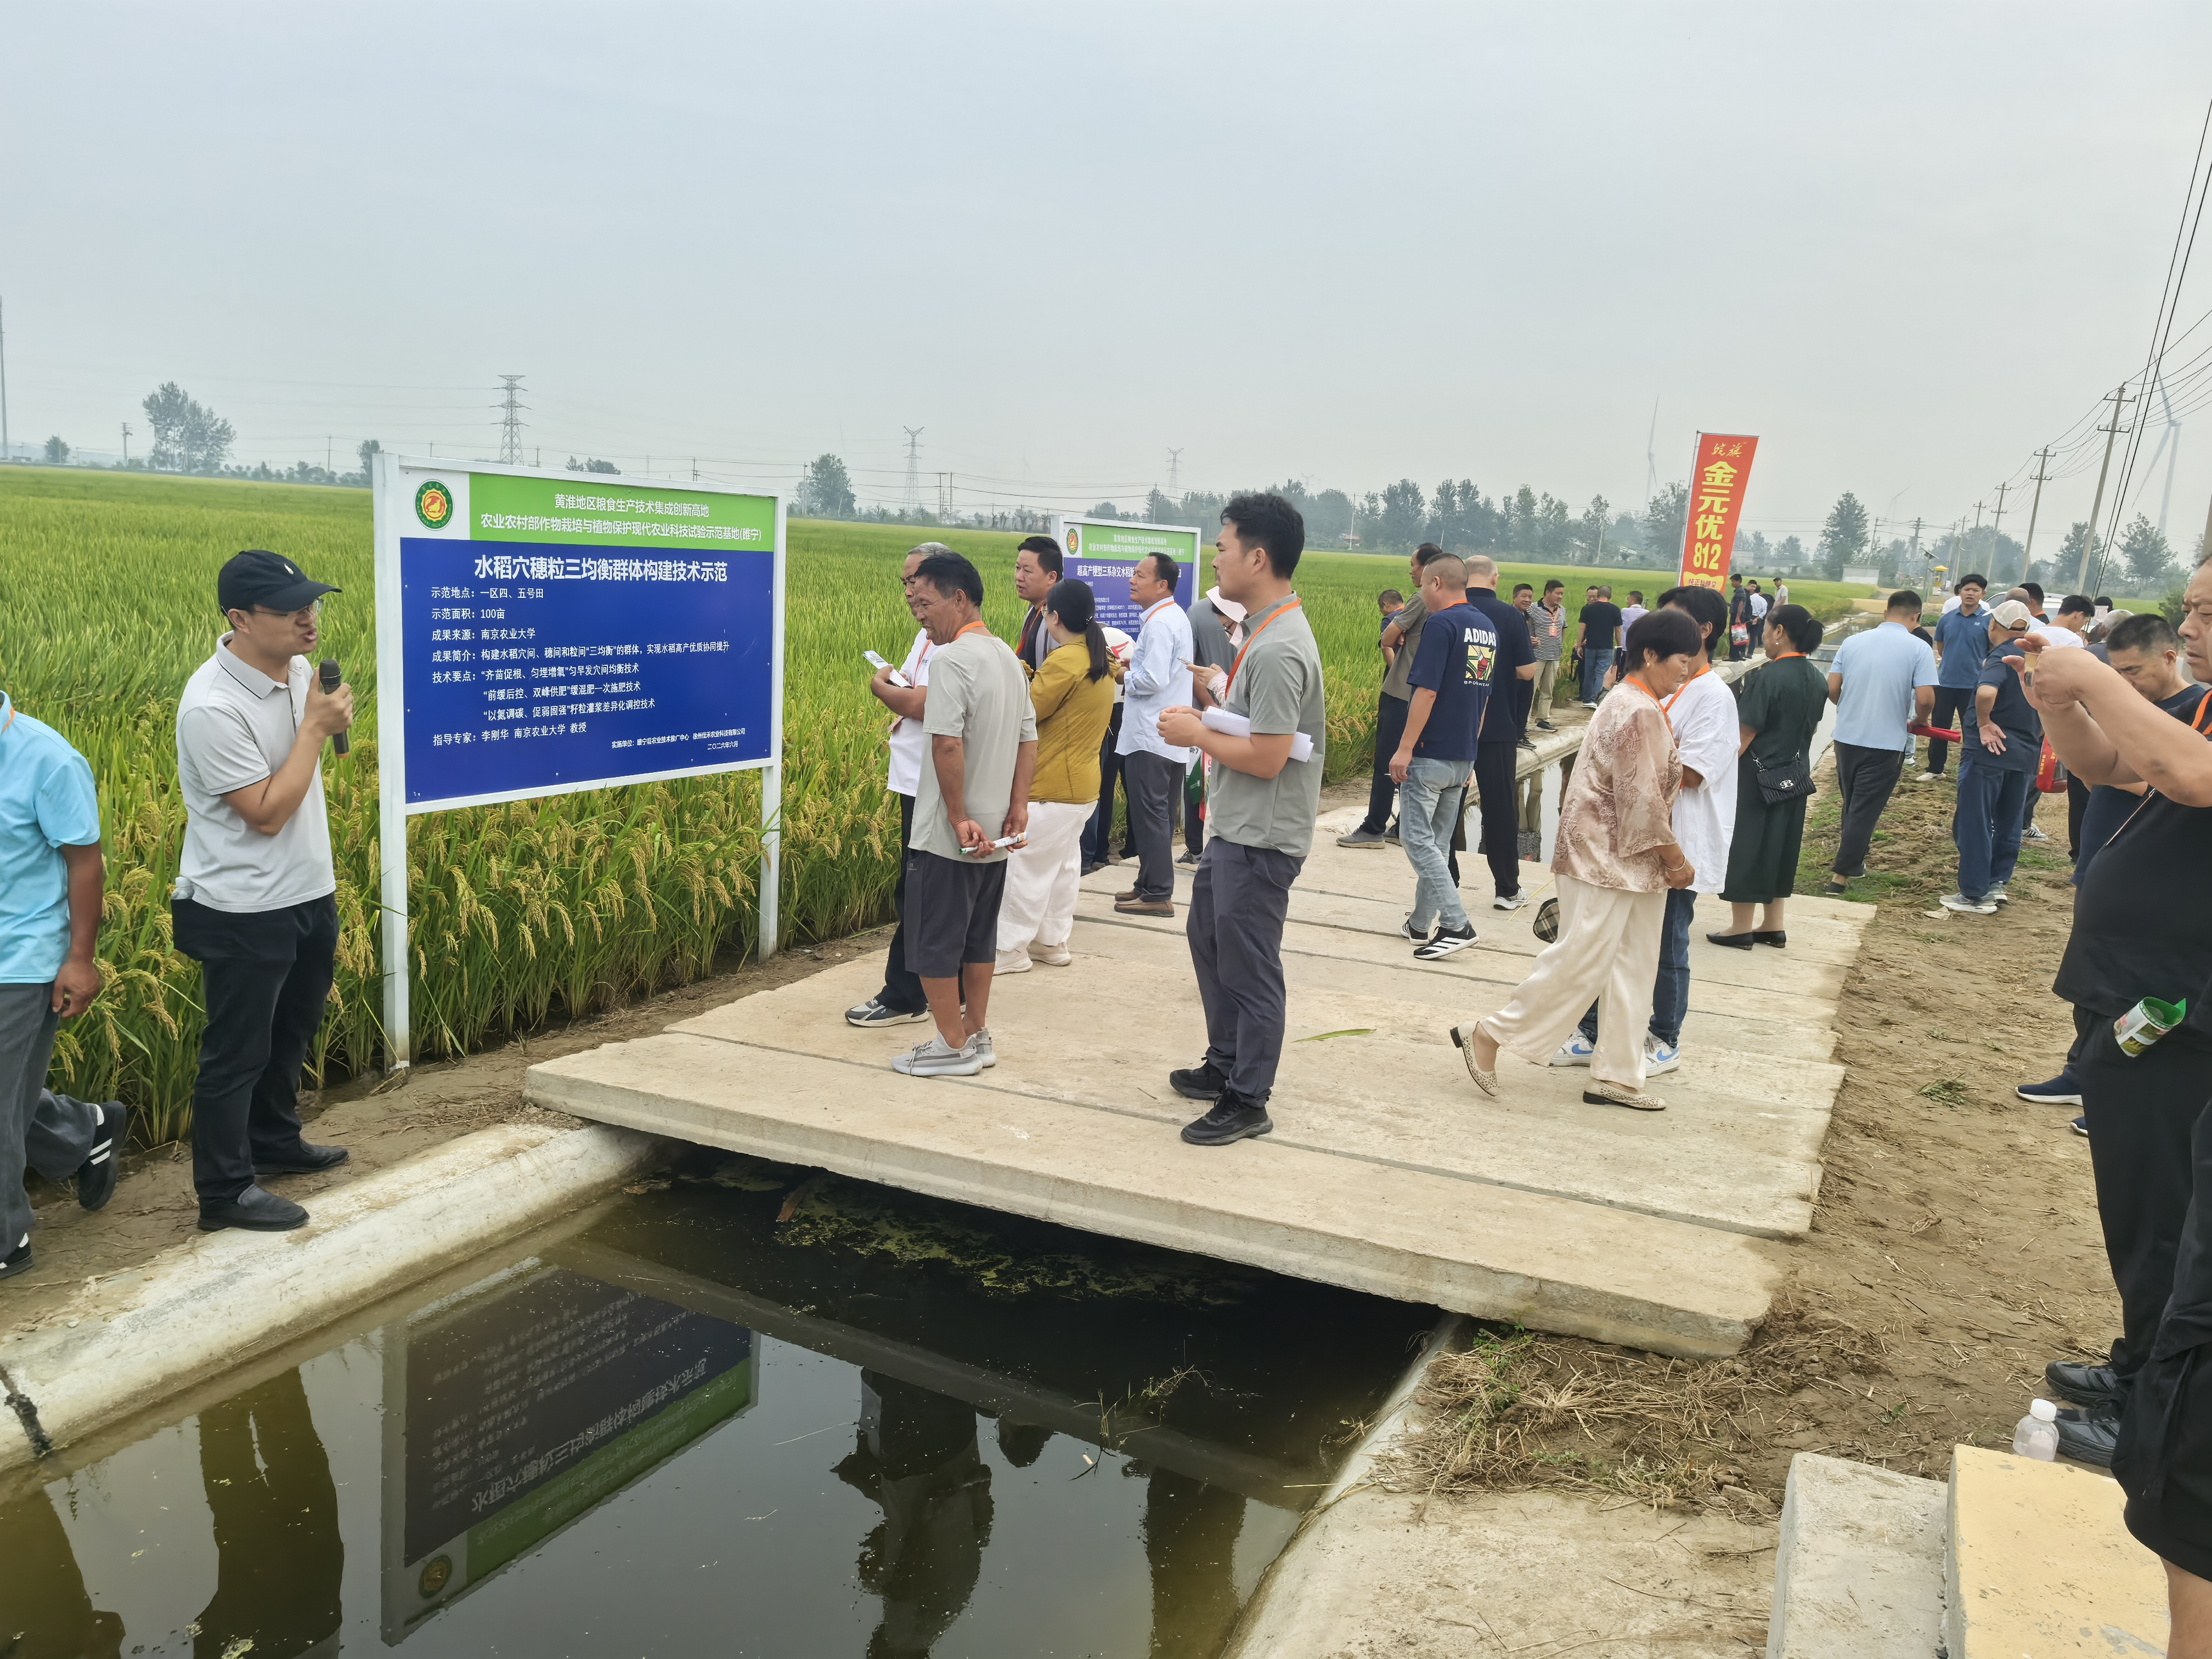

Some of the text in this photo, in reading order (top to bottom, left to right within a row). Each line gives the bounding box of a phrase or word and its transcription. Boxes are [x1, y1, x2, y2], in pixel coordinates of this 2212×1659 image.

[555, 493, 709, 517] 黄淮地区粮食生产技术集成创新高地
[1695, 461, 1737, 541] 金元优
[474, 554, 727, 582] 水稻穴穗粒三均衡群体构建技术示范
[1693, 542, 1722, 570] 812
[430, 586, 544, 599] 示范地点：一区四、五号田
[431, 608, 505, 620] 示范面积：100亩
[432, 628, 536, 641] 成果来源：南京农业大学
[1464, 628, 1496, 647] ADIDAS
[433, 721, 587, 746] 指导专家：李刚华 南京农业大学 教授
